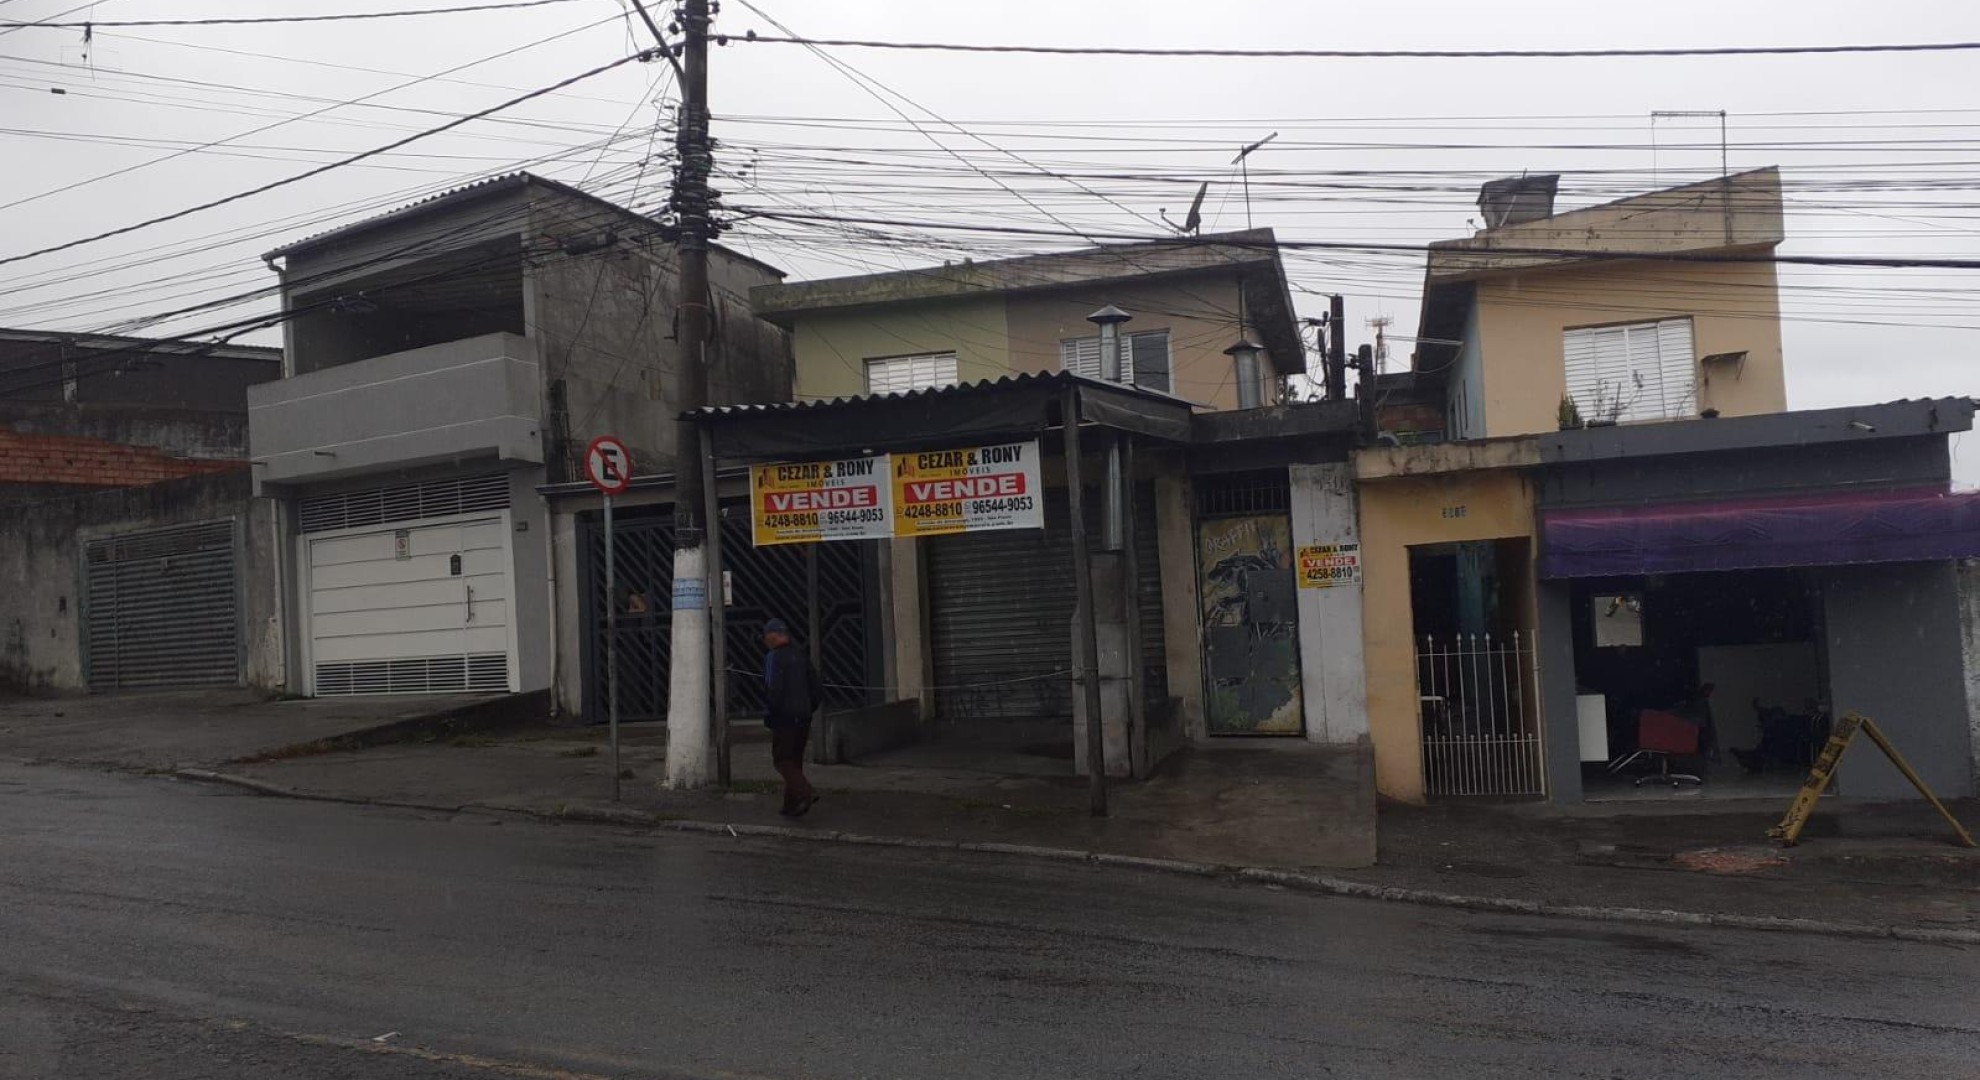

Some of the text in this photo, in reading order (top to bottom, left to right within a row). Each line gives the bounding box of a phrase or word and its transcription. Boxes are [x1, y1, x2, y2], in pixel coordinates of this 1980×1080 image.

[918, 445, 1022, 469] CEZAR & RONY
[778, 459, 874, 481] CEZAR & RONY
[911, 475, 1019, 501] VENDE
[771, 488, 870, 511] VENDE
[904, 496, 1033, 519] 4248-8810 96544-9053
[765, 508, 884, 529] 4248-8810 96544-9053
[1307, 566, 1353, 579] 4258-8810
[1308, 556, 1353, 567] VENDE
